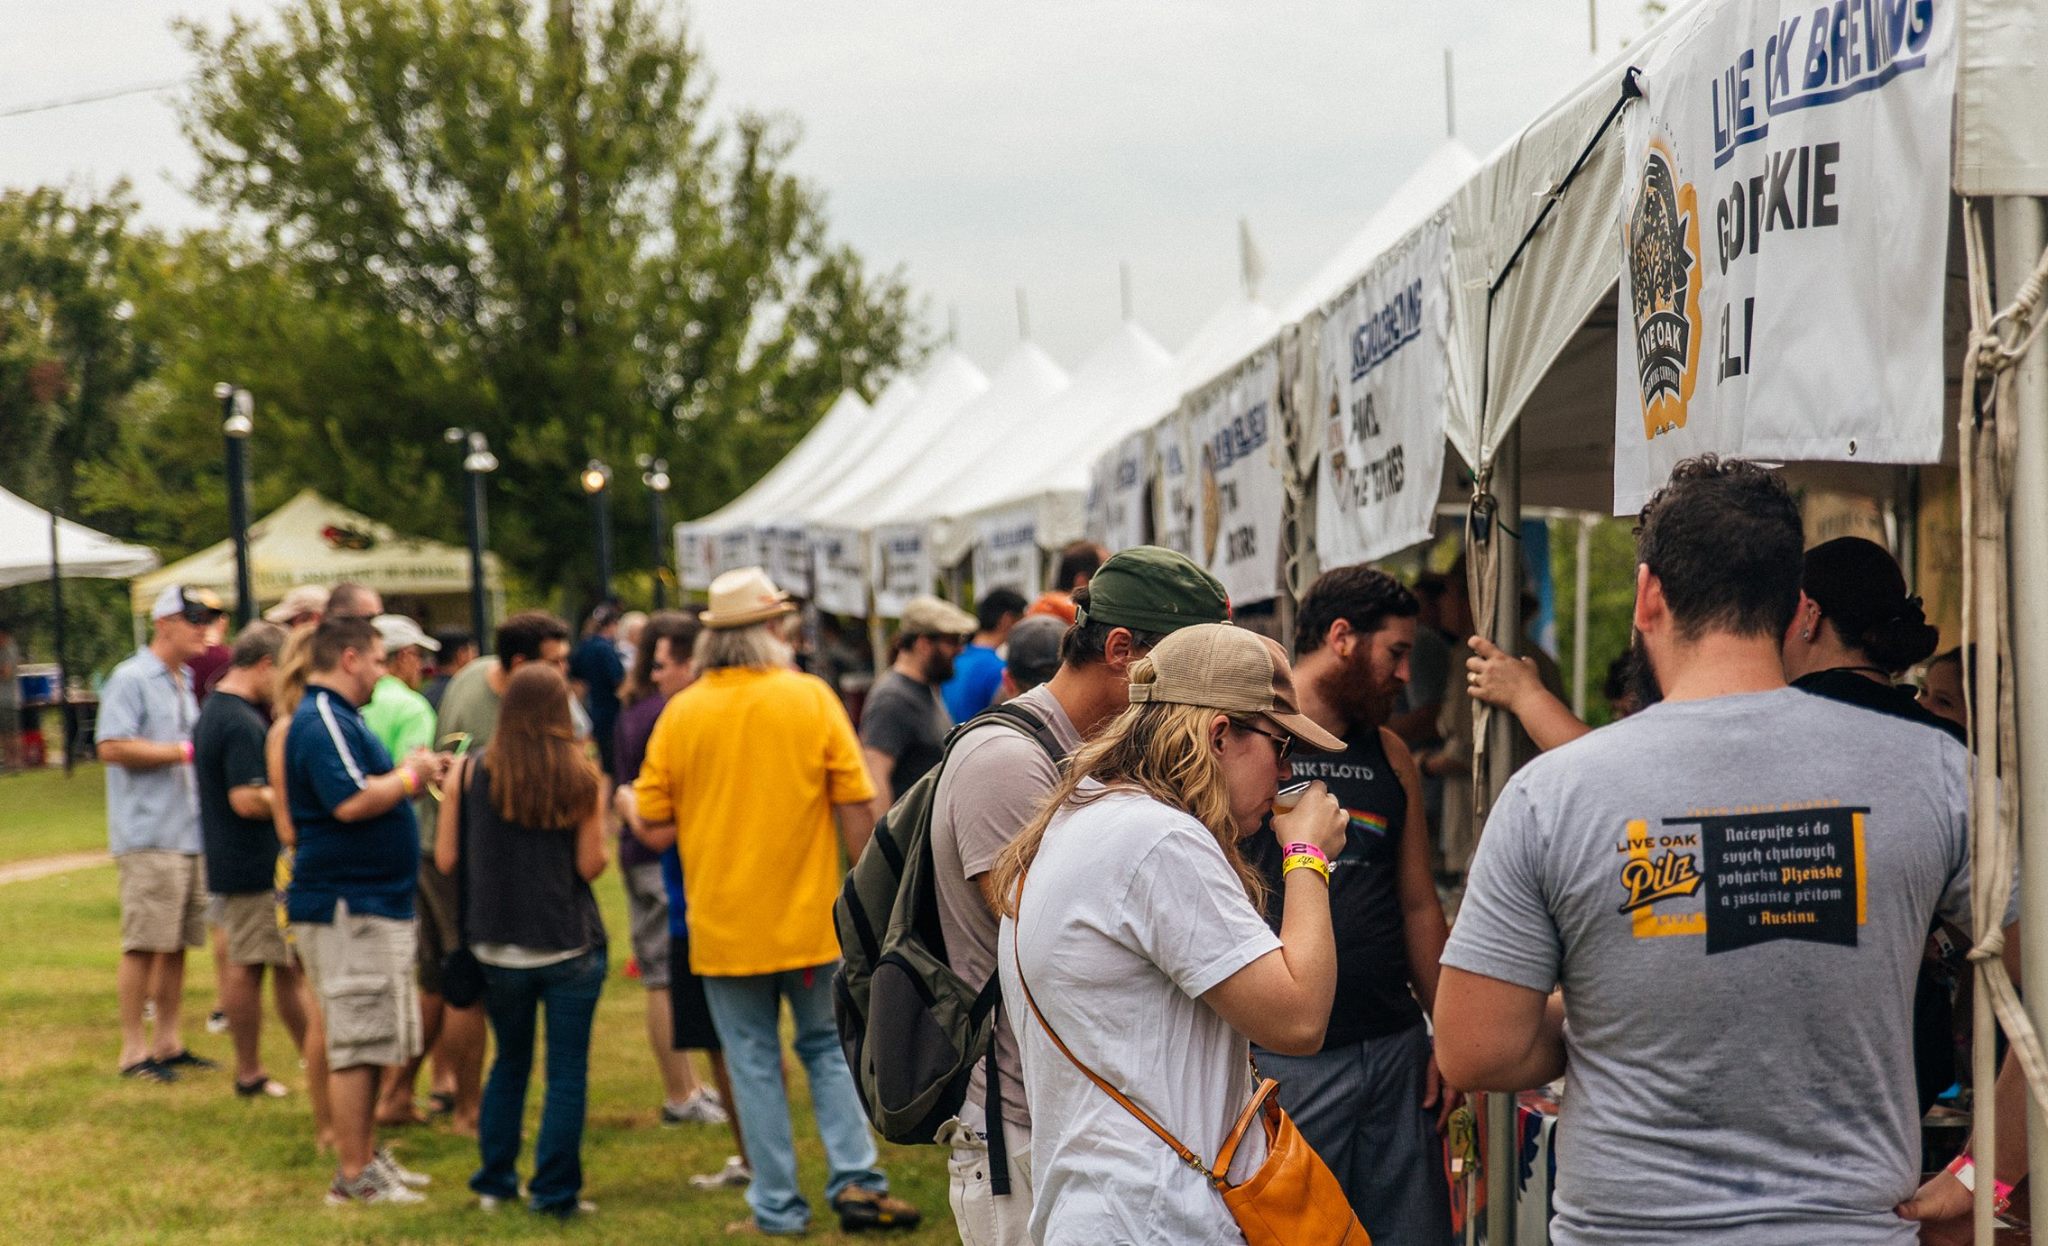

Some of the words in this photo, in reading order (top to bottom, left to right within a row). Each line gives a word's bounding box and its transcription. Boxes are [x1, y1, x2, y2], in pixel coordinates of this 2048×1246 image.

[1712, 48, 1754, 154] LIVE
[1657, 320, 1682, 353] OAK
[1291, 761, 1318, 777] NK
[1320, 762, 1374, 781] FLOYD
[1797, 821, 1809, 837] si
[1813, 821, 1830, 836] do
[1616, 837, 1655, 853] LIVE
[1659, 834, 1697, 848] OAK
[1618, 849, 1704, 915] Pilz
[1721, 894, 1730, 906] a
